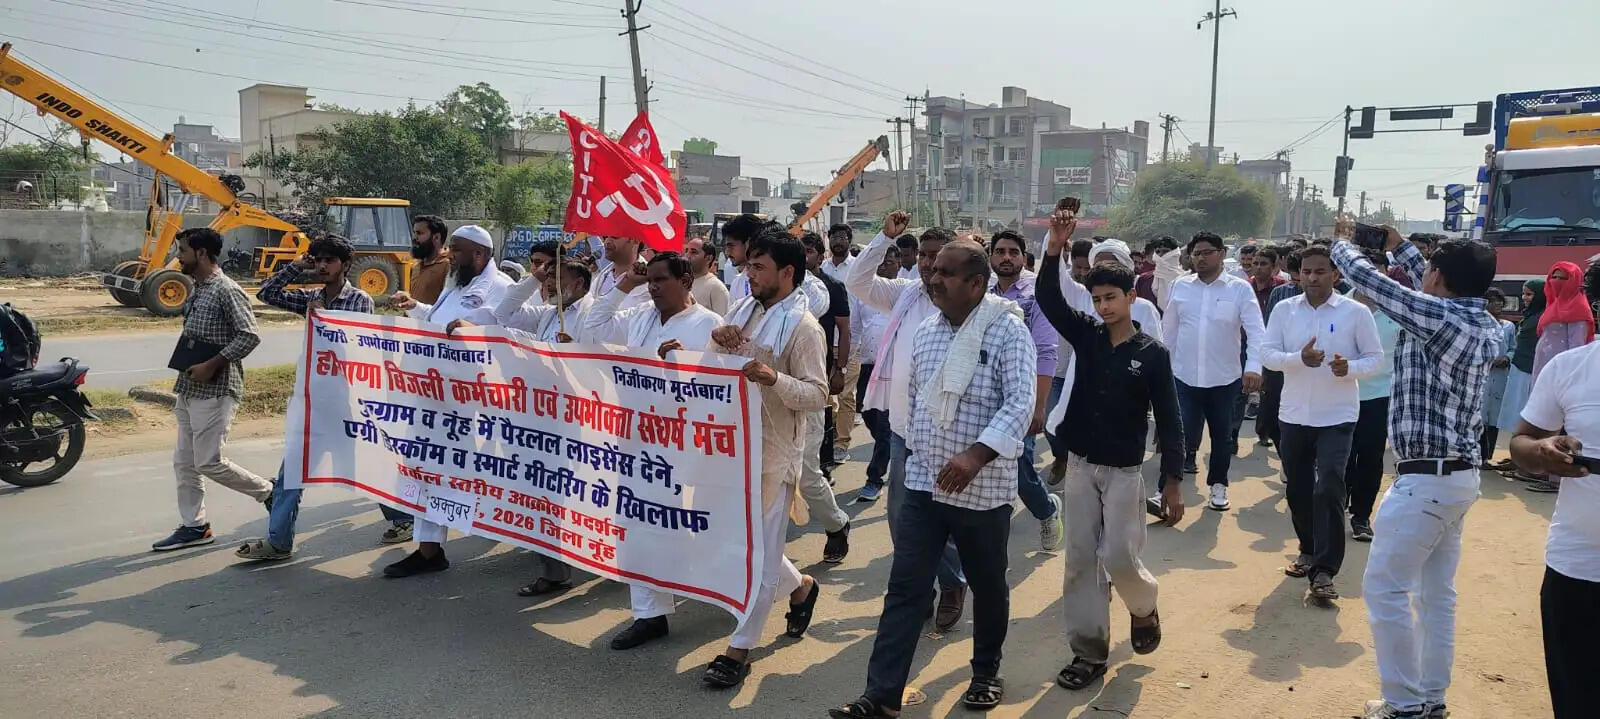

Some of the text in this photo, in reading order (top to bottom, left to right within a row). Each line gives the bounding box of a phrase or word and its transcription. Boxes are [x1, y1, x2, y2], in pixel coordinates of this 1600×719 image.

[36, 92, 149, 154] INDO SHAKTI
[576, 130, 599, 219] CITU
[356, 334, 400, 353] उपभोक्ता
[404, 341, 435, 359] एकता
[438, 343, 492, 365] जिंदाबाद!
[612, 366, 666, 394] निजीकरण
[384, 361, 444, 403] बिजली
[449, 373, 527, 413] कर्मचारी
[533, 385, 559, 419] एवं
[563, 390, 634, 440] उपभोक्ता
[692, 413, 737, 457] मंच
[343, 419, 378, 444] एग्री
[452, 447, 468, 469] व
[473, 453, 520, 481] स्मार्ट
[525, 460, 587, 501] मीटरिंग
[591, 478, 611, 508] के
[615, 485, 710, 532] खिलाफ
[422, 408, 437, 430] व
[443, 411, 472, 441] नूंह
[477, 414, 497, 440] में
[499, 417, 562, 455] पैरलल
[566, 438, 636, 477] लाइसेंस
[641, 451, 682, 495] देने,
[397, 463, 444, 486] सर्कल
[448, 475, 504, 499] स्तरीय
[508, 490, 567, 520] आक्रोश
[571, 510, 627, 542] प्रदर्शन
[493, 507, 534, 531] 2026
[540, 517, 583, 548] जिला
[588, 538, 617, 563] नूंह
